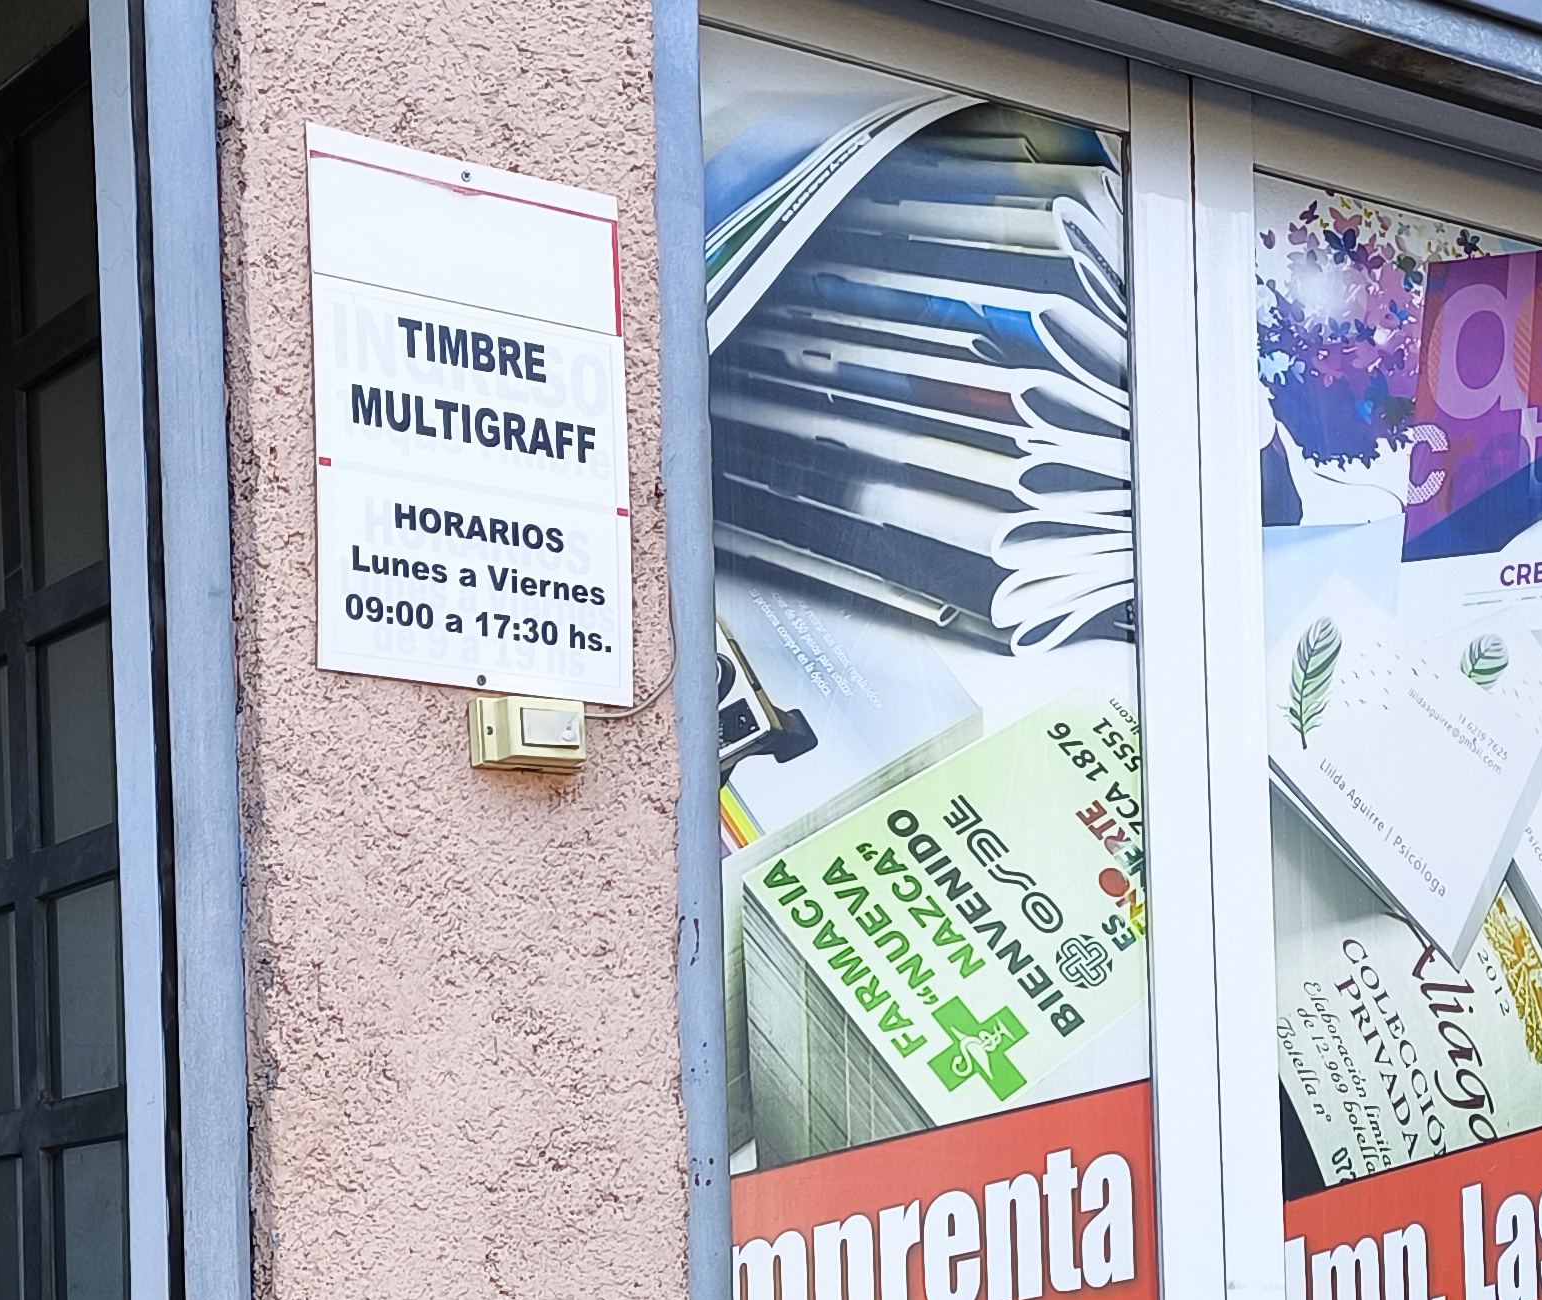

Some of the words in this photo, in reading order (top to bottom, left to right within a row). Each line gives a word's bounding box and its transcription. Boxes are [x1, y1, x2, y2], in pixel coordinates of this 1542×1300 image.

[397, 316, 548, 384] TIMBRE
[350, 382, 597, 464] MULTIGRAFF
[393, 502, 565, 554] HORARIOS
[351, 543, 448, 587] Lunes
[459, 566, 477, 589] a
[487, 565, 607, 606] Viernes
[344, 593, 435, 632] 09:00
[444, 613, 464, 635] a
[474, 611, 559, 647] 17:30
[568, 622, 614, 654] hs.
[777, 626, 801, 655] compra
[1046, 721, 1109, 782] 1876
[942, 793, 1065, 935] OSDE
[1346, 788, 1385, 832] Aguirre
[1393, 835, 1446, 897] Psicóloga
[887, 809, 1085, 1038] BIENVENIDO
[762, 859, 928, 1059] FARMACIA
[1477, 949, 1511, 1017] 2012
[1297, 1007, 1318, 1028] de
[1303, 981, 1367, 1098] Elaboración
[1334, 977, 1419, 1160] PRIVADA
